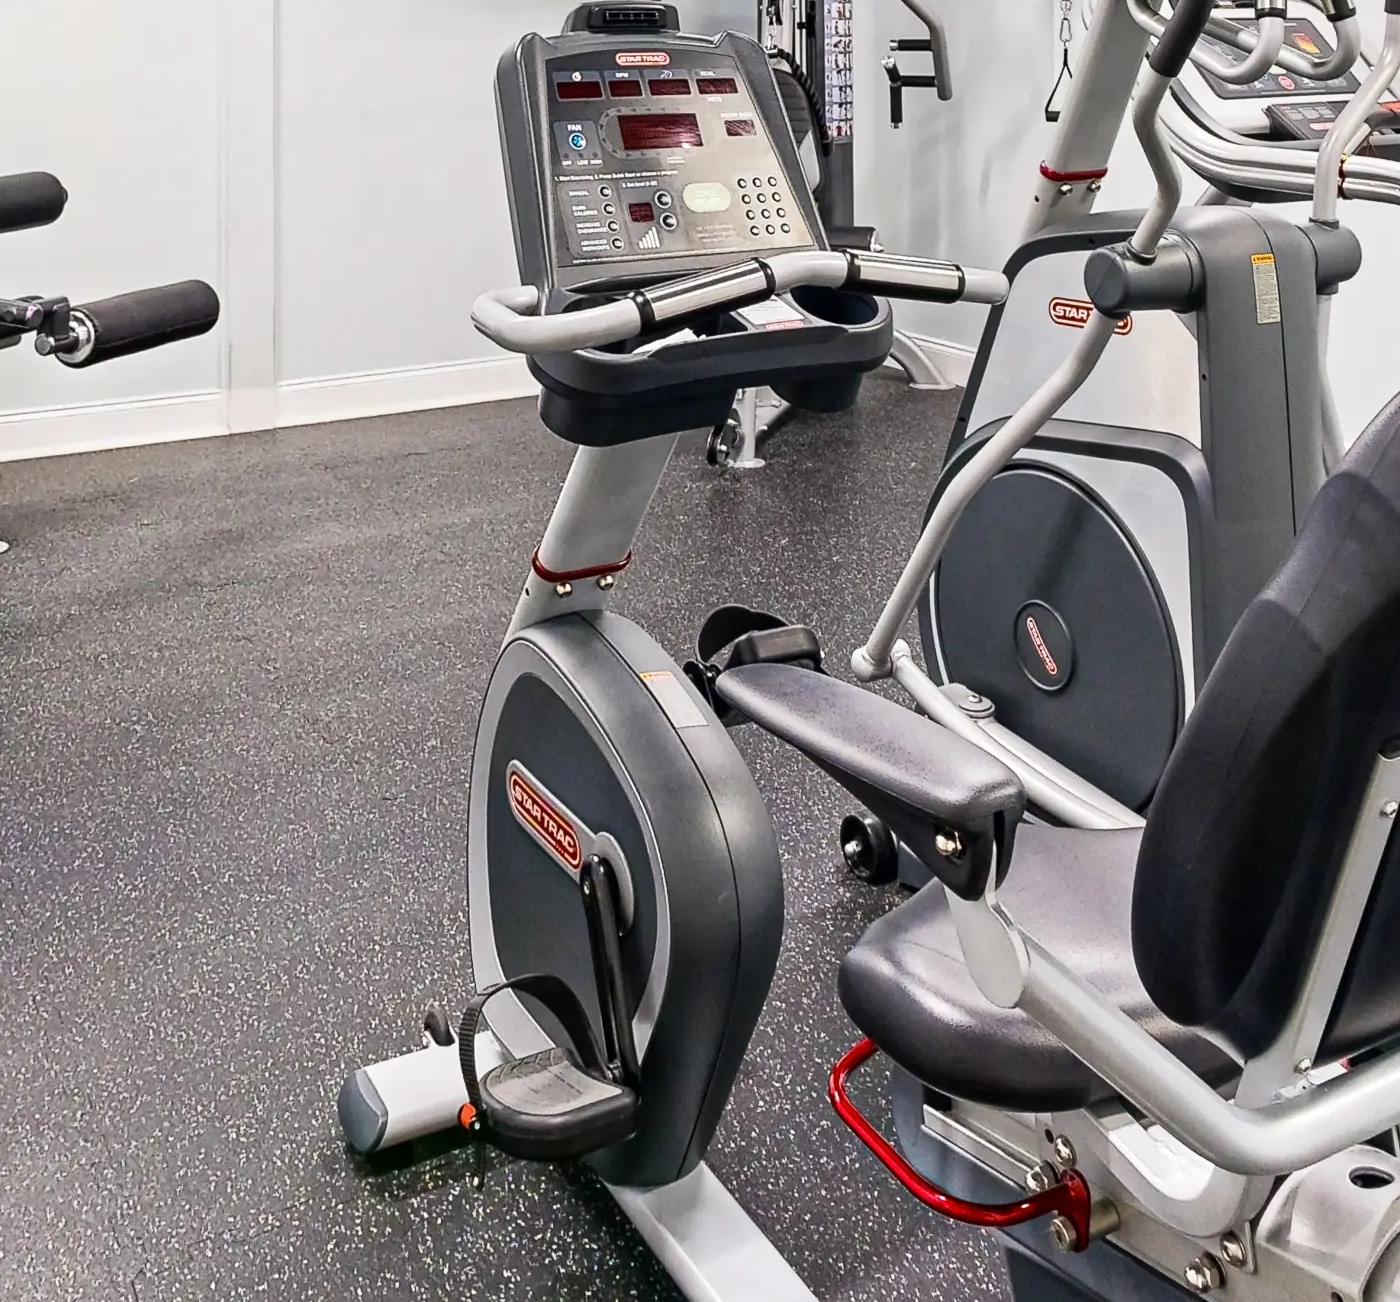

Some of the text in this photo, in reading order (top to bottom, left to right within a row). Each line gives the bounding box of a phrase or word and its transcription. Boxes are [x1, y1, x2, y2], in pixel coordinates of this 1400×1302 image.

[619, 54, 665, 63] STAR TRAC
[567, 124, 582, 132] FAN
[1055, 304, 1088, 321] STAR
[513, 785, 575, 853] STAR TRAC
